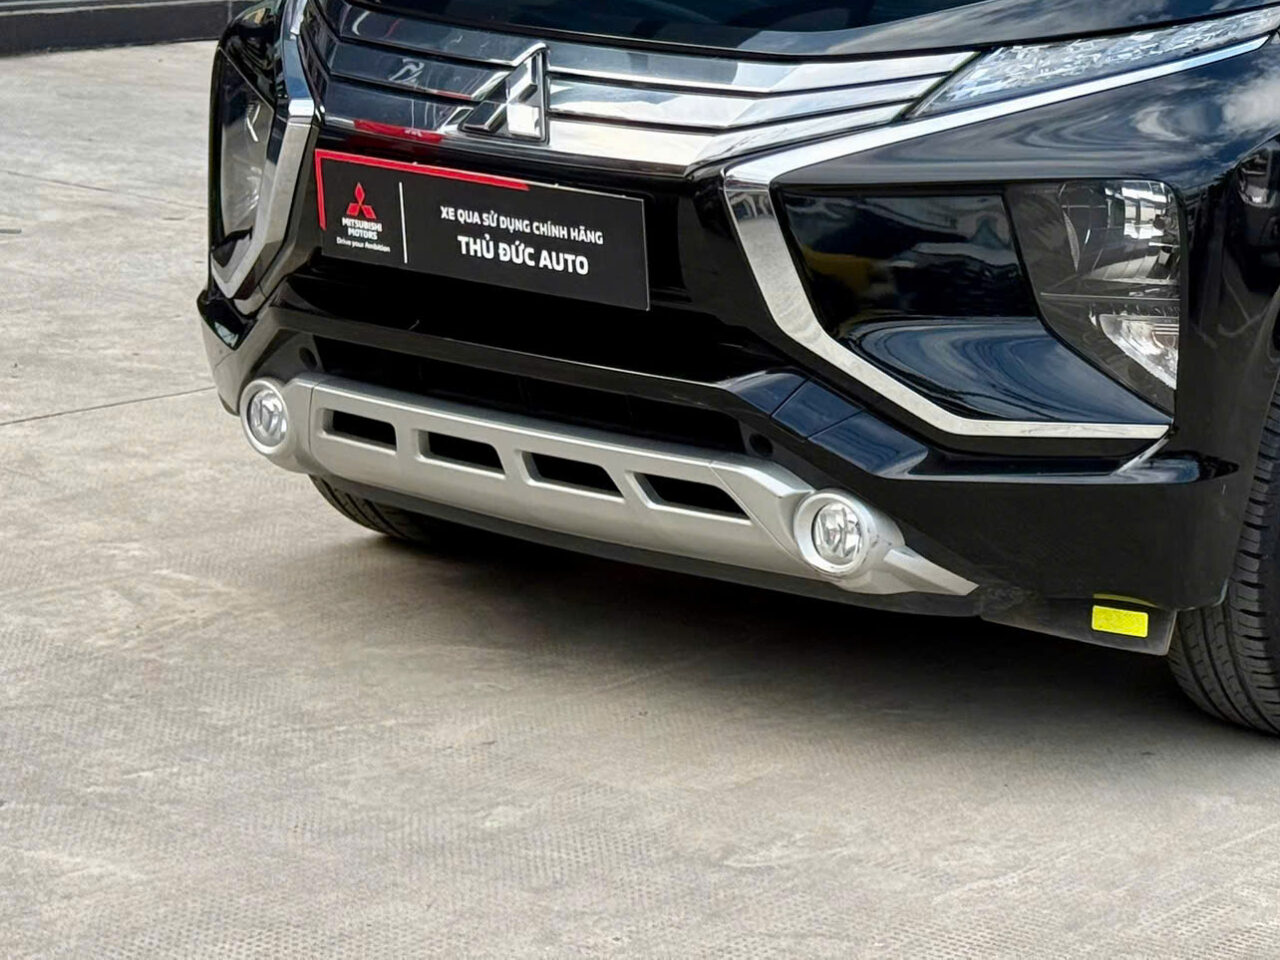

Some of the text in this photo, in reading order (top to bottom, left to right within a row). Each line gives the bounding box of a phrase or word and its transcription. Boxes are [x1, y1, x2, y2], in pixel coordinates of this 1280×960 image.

[341, 216, 383, 232] MITSUBISHI
[347, 227, 378, 240] MOTORS
[440, 205, 604, 245] XE QUA SỬ DỤNG CHÍNH HÃNG
[457, 233, 589, 276] THỦ ĐỨC AUTO
